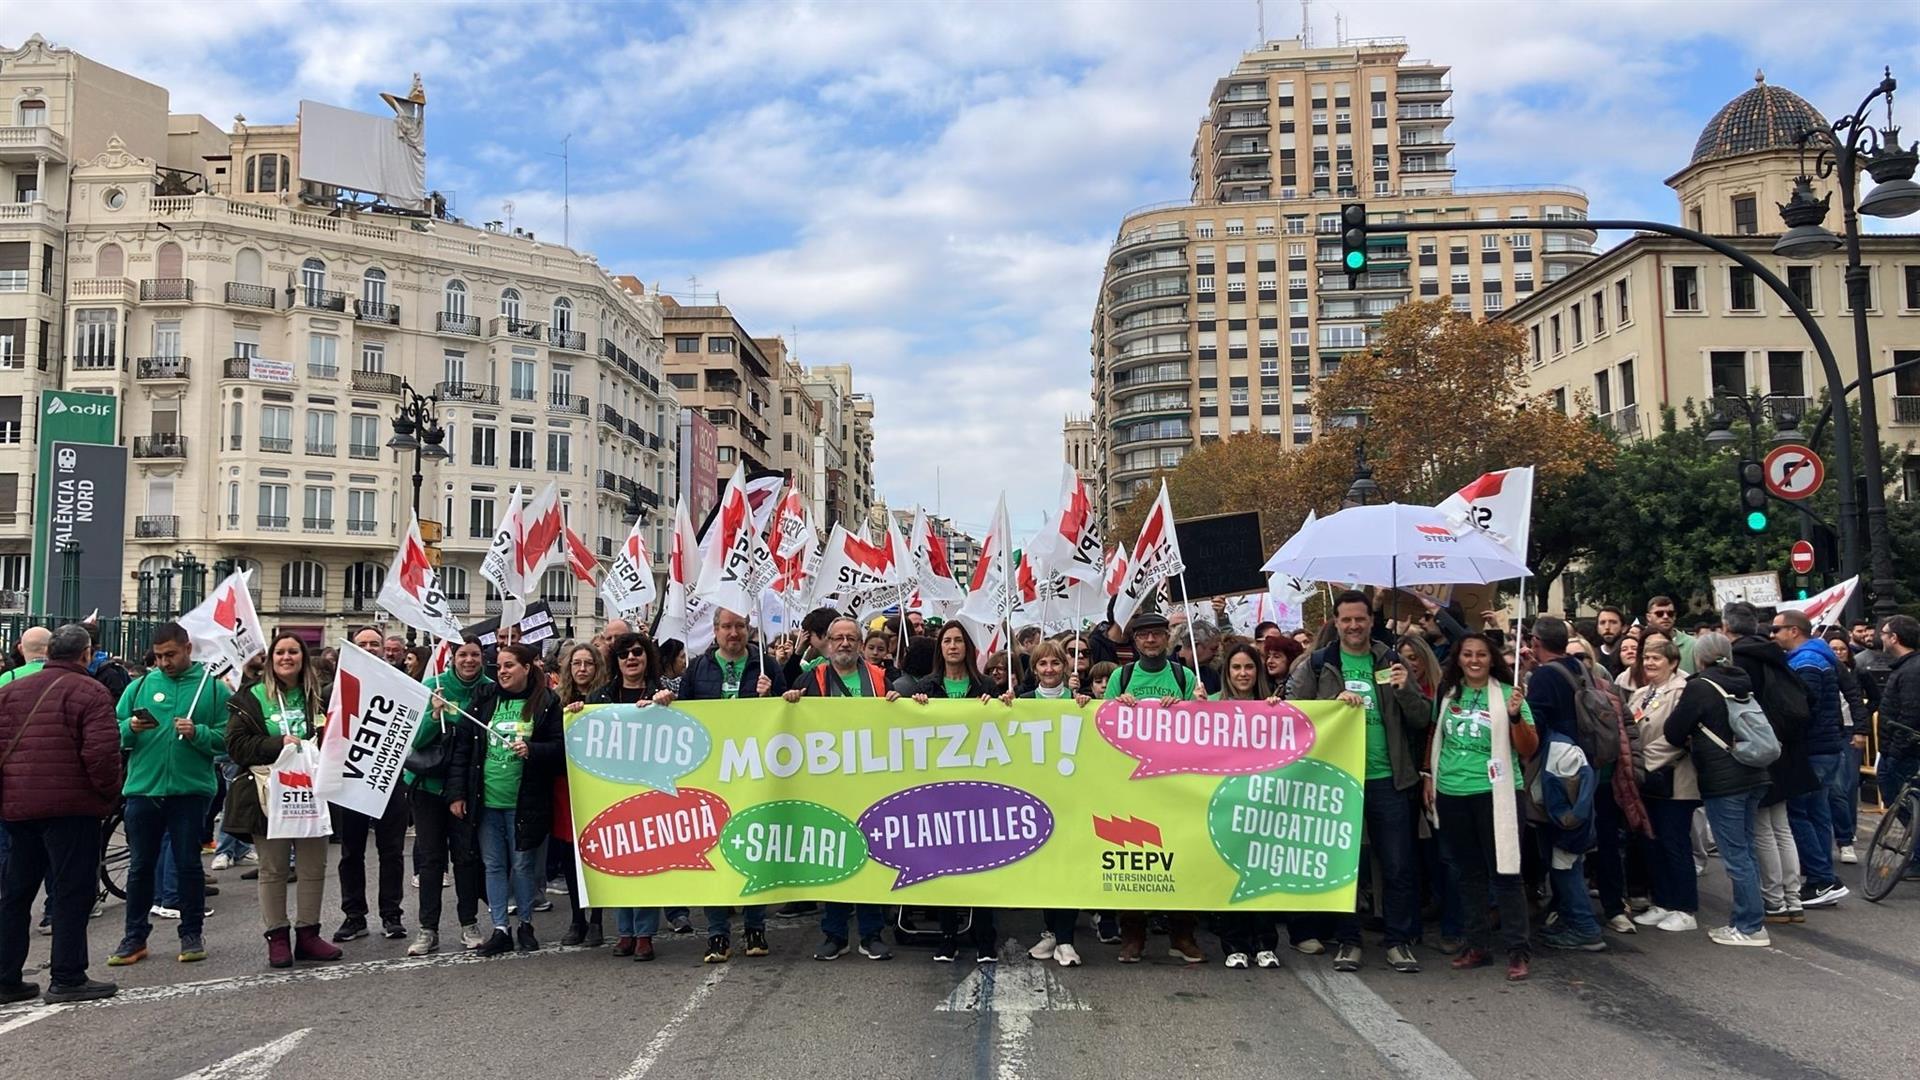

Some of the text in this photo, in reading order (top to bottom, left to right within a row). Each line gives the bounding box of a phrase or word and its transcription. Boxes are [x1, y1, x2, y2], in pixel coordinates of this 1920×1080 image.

[70, 404, 111, 416] adif
[53, 479, 75, 552] VALÈNCIA
[76, 480, 94, 522] NORD
[1425, 535, 1458, 543] STEPV
[572, 711, 694, 766] -RÀTIOS
[718, 714, 1083, 783] MOBILITZA'T!
[1105, 705, 1297, 751] -BUROCRÀCIA
[1247, 774, 1345, 815] CENTRES
[586, 799, 718, 859] +VALENCIÀ
[731, 822, 847, 869] +SALARI
[870, 804, 1038, 850] +PLANTILLES
[1231, 804, 1352, 850] EDUCATIUS
[1101, 850, 1174, 871] STEPV
[1102, 872, 1176, 883] INTERSINDICAL
[1247, 840, 1328, 879] DIGNES
[1114, 883, 1176, 893] VALENCIANA
